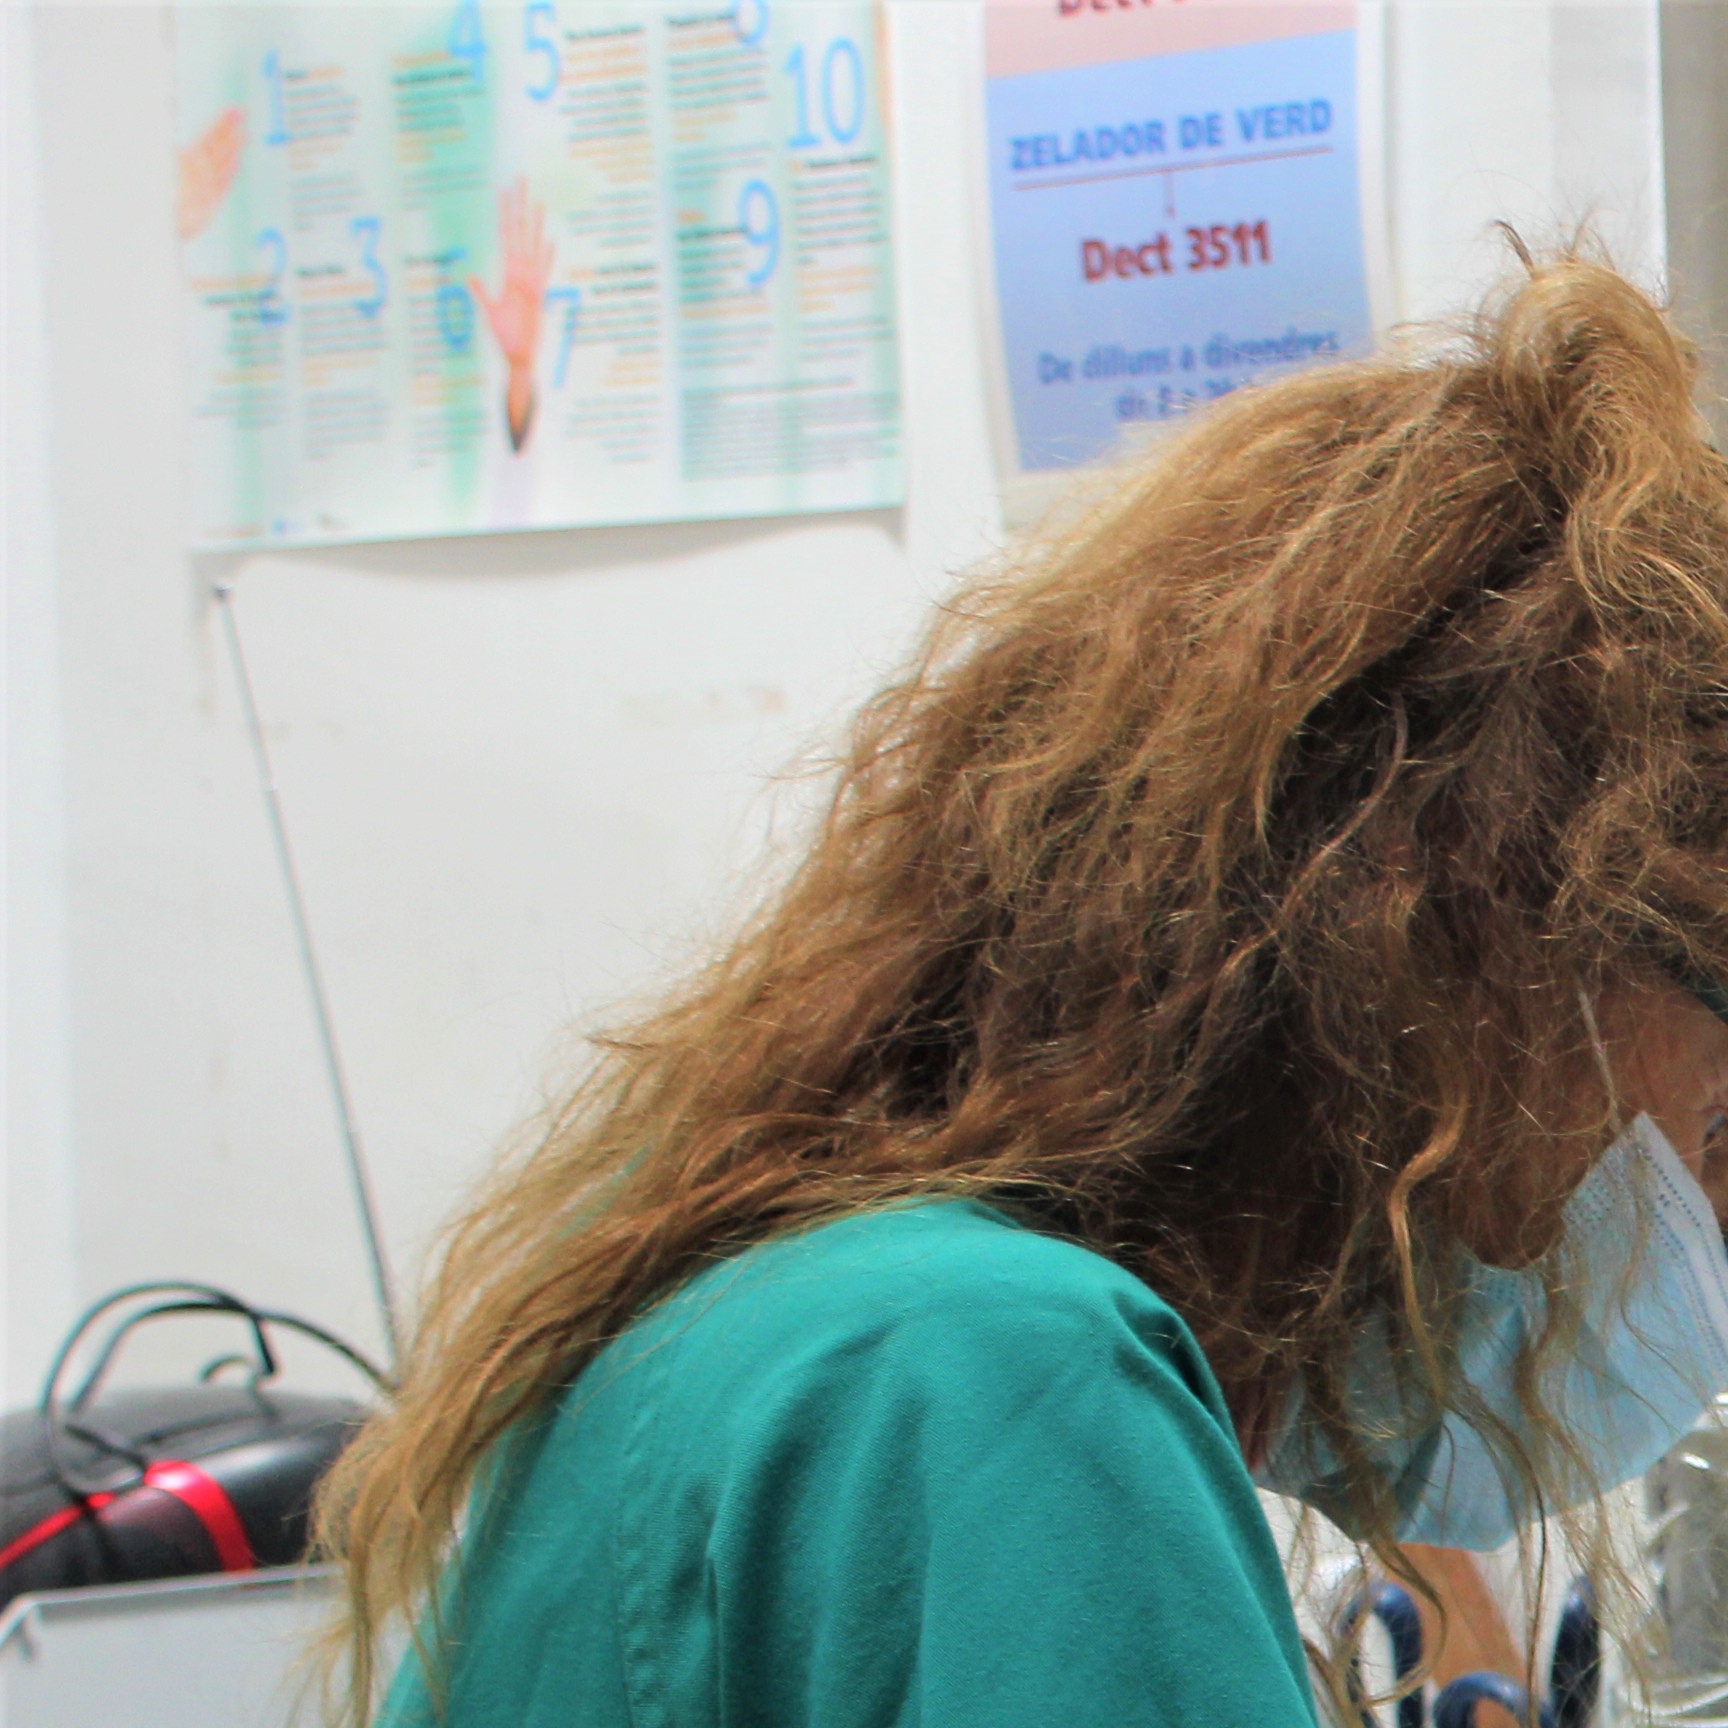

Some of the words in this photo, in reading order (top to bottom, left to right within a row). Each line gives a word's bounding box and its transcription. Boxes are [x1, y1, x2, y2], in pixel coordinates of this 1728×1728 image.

[787, 38, 865, 147] 10
[1009, 119, 1166, 171] ZELADOR
[1177, 111, 1223, 150] DE
[1235, 97, 1331, 142] VERD
[739, 179, 781, 289] 9
[1082, 234, 1172, 281] Dect
[1186, 219, 1269, 270] 3511
